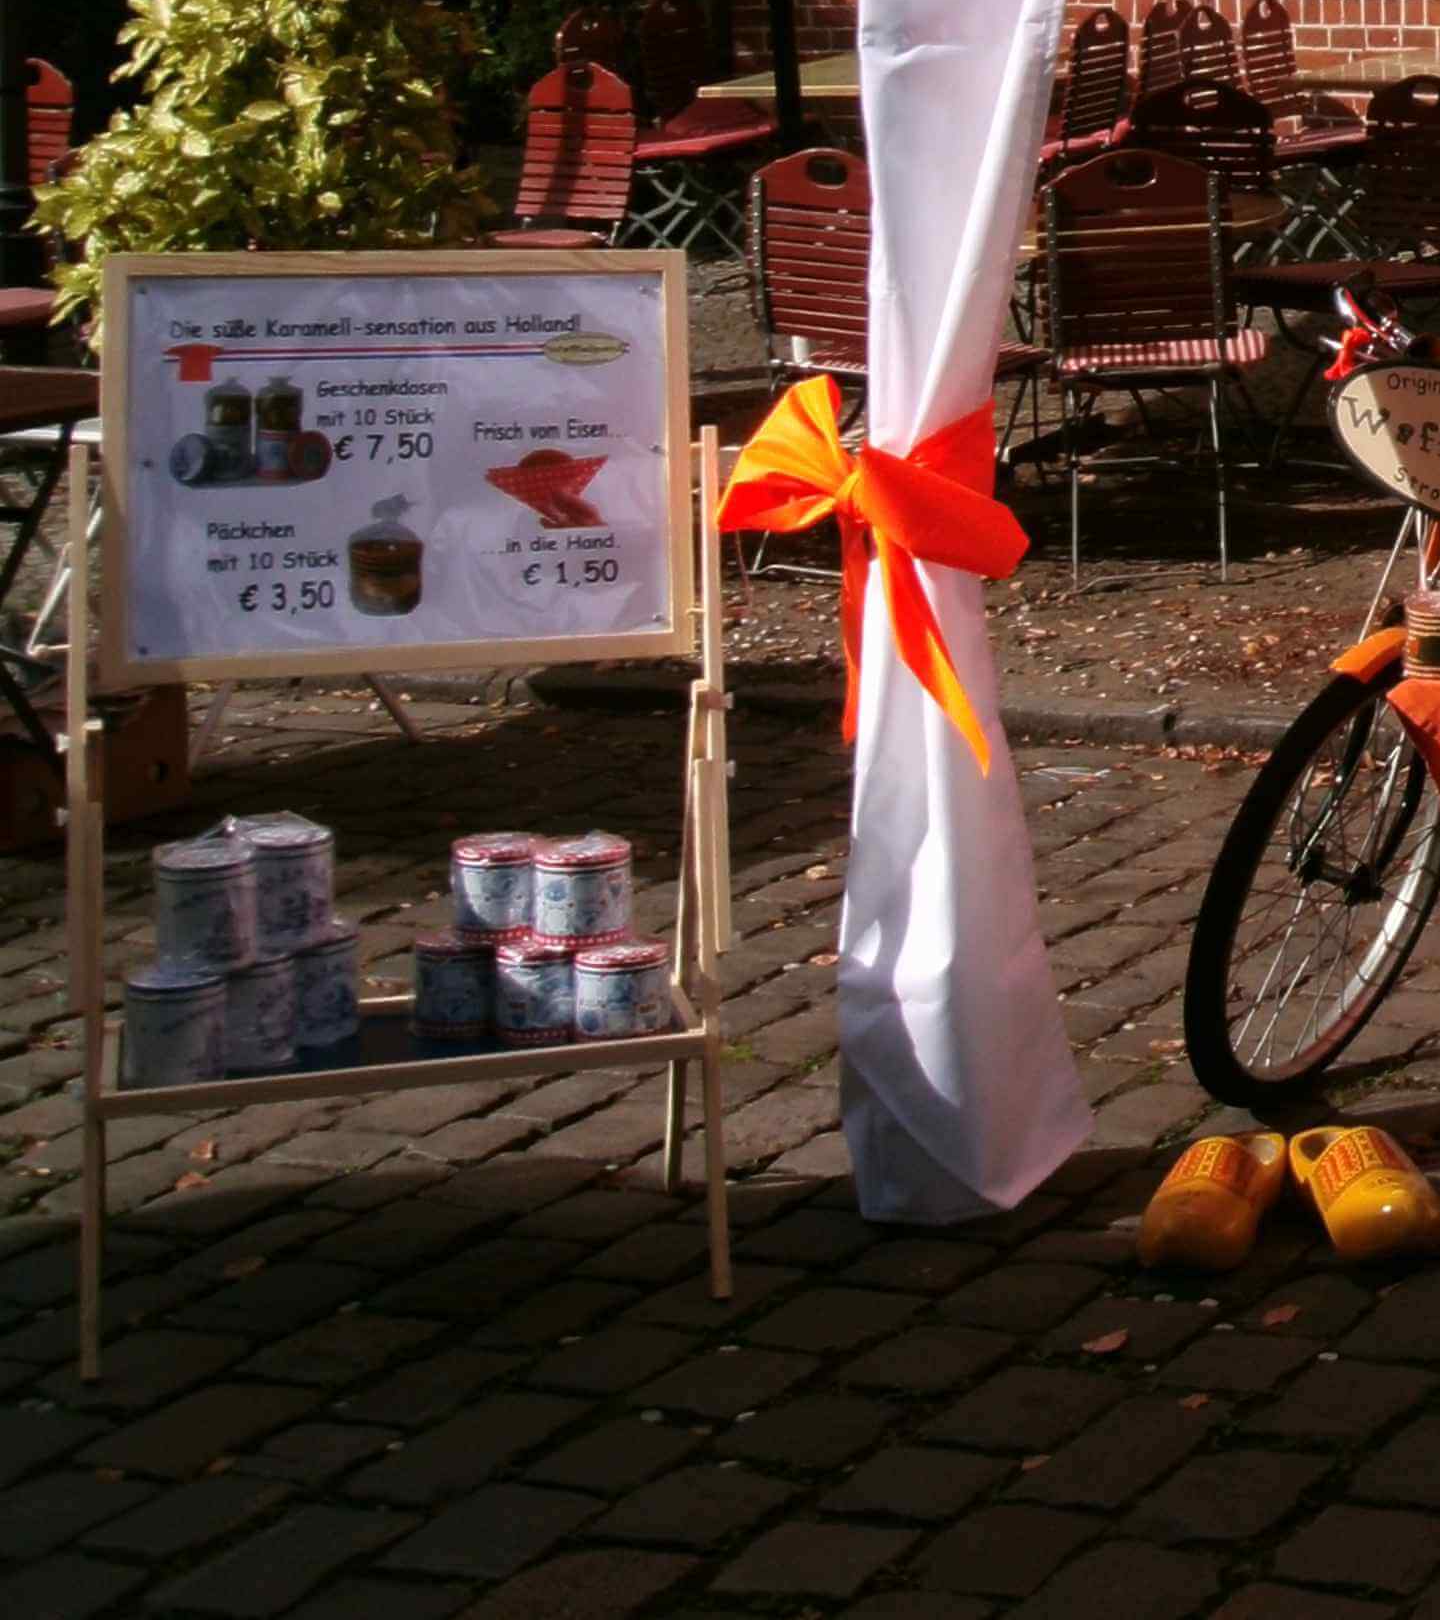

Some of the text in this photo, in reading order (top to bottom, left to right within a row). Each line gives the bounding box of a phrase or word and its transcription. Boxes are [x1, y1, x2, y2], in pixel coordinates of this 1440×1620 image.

[169, 319, 203, 339] Die
[212, 318, 257, 339] süße
[265, 315, 456, 338] Karamell-sensation
[463, 318, 497, 334] aus
[316, 379, 448, 398] Geschenkdosen
[316, 406, 435, 427] mit 10 Stück
[473, 421, 523, 442] Frisch
[528, 425, 561, 440] vom
[333, 431, 434, 466] € 7,50
[206, 522, 296, 540] Päckchen
[529, 536, 558, 552] die
[207, 548, 339, 573] mit 10 Stück
[521, 558, 619, 589] € 1,50
[238, 579, 335, 616] € 3,50
